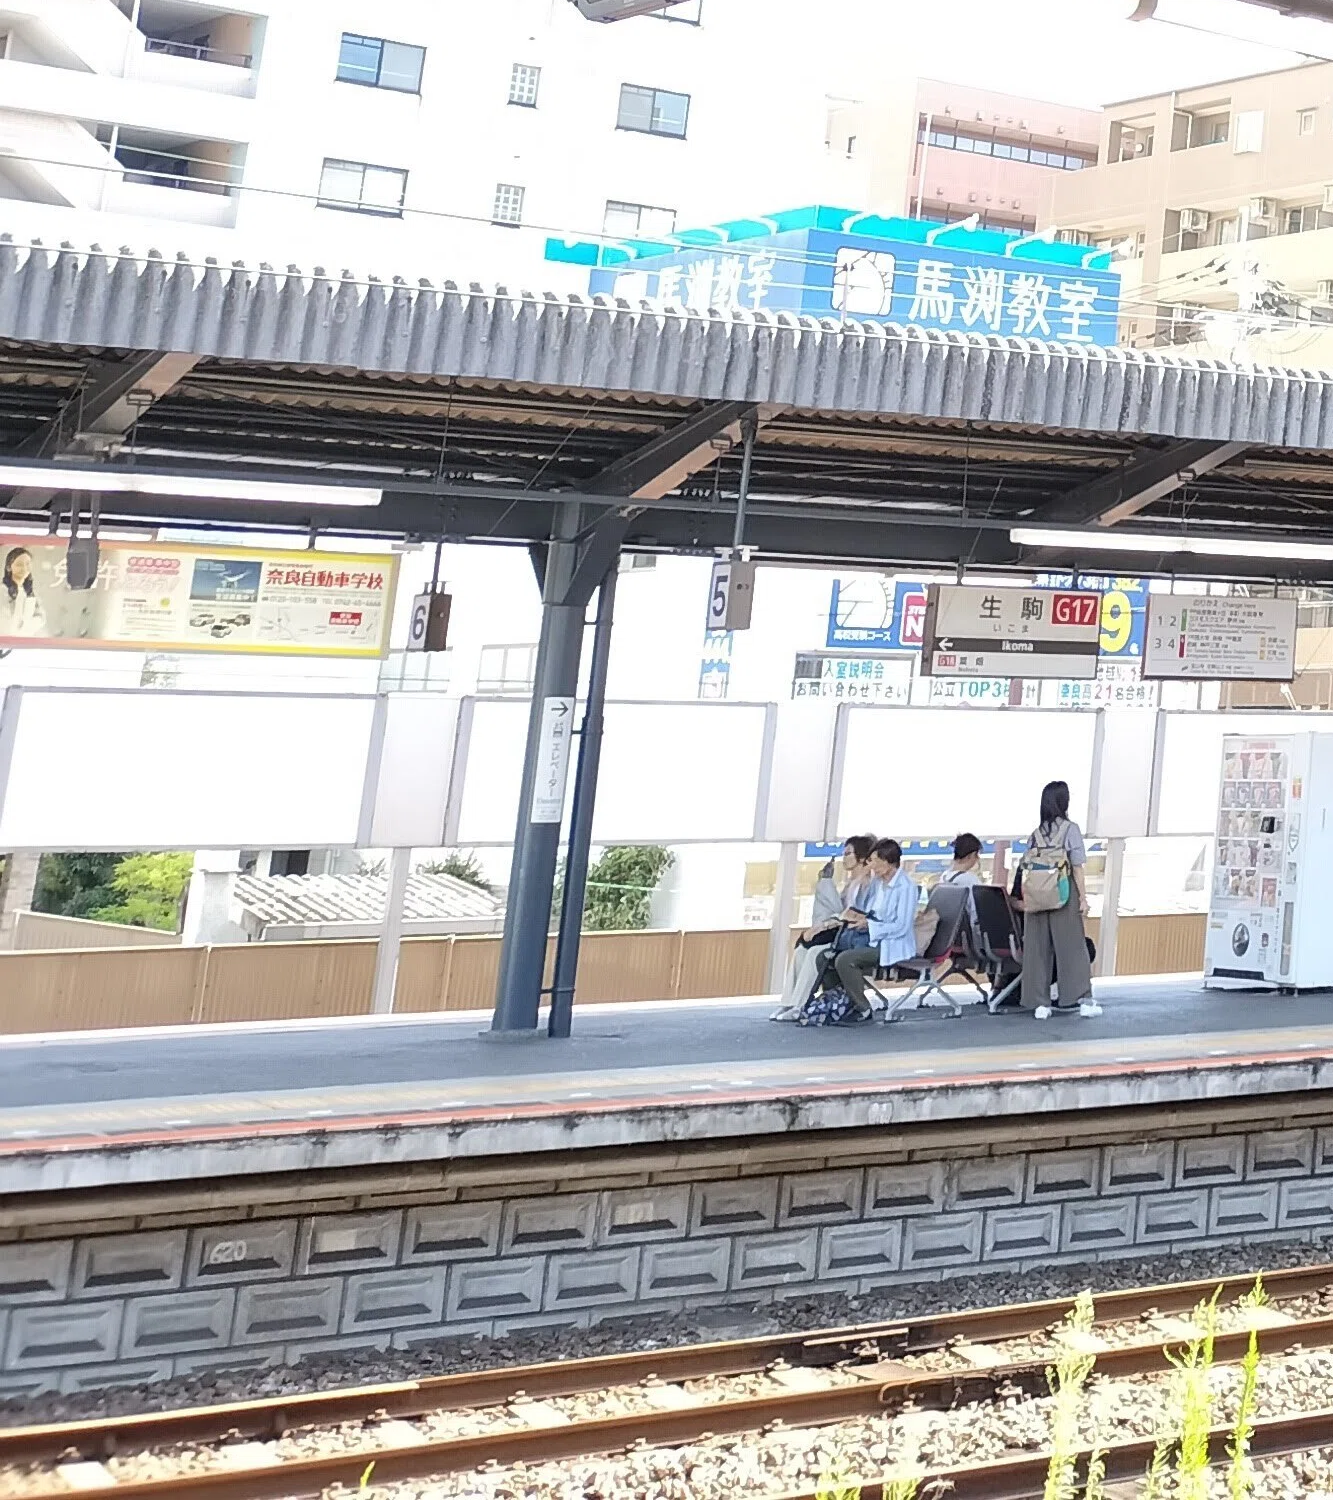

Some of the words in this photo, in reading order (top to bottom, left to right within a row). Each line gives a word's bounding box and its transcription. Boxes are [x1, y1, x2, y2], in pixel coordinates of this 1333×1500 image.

[266, 568, 383, 590] 奈良自動車学校
[711, 574, 726, 618] 5
[979, 595, 1043, 621] 生駒
[1056, 598, 1096, 623] G17
[413, 605, 426, 641] 6
[993, 624, 1029, 634] いこま
[1158, 616, 1163, 625] 1
[1170, 616, 1177, 626] 2
[1002, 640, 1034, 652] Ikoma
[1155, 638, 1161, 648] 3
[1168, 638, 1175, 648] 4
[796, 682, 906, 698] お問い合わせ下さい
